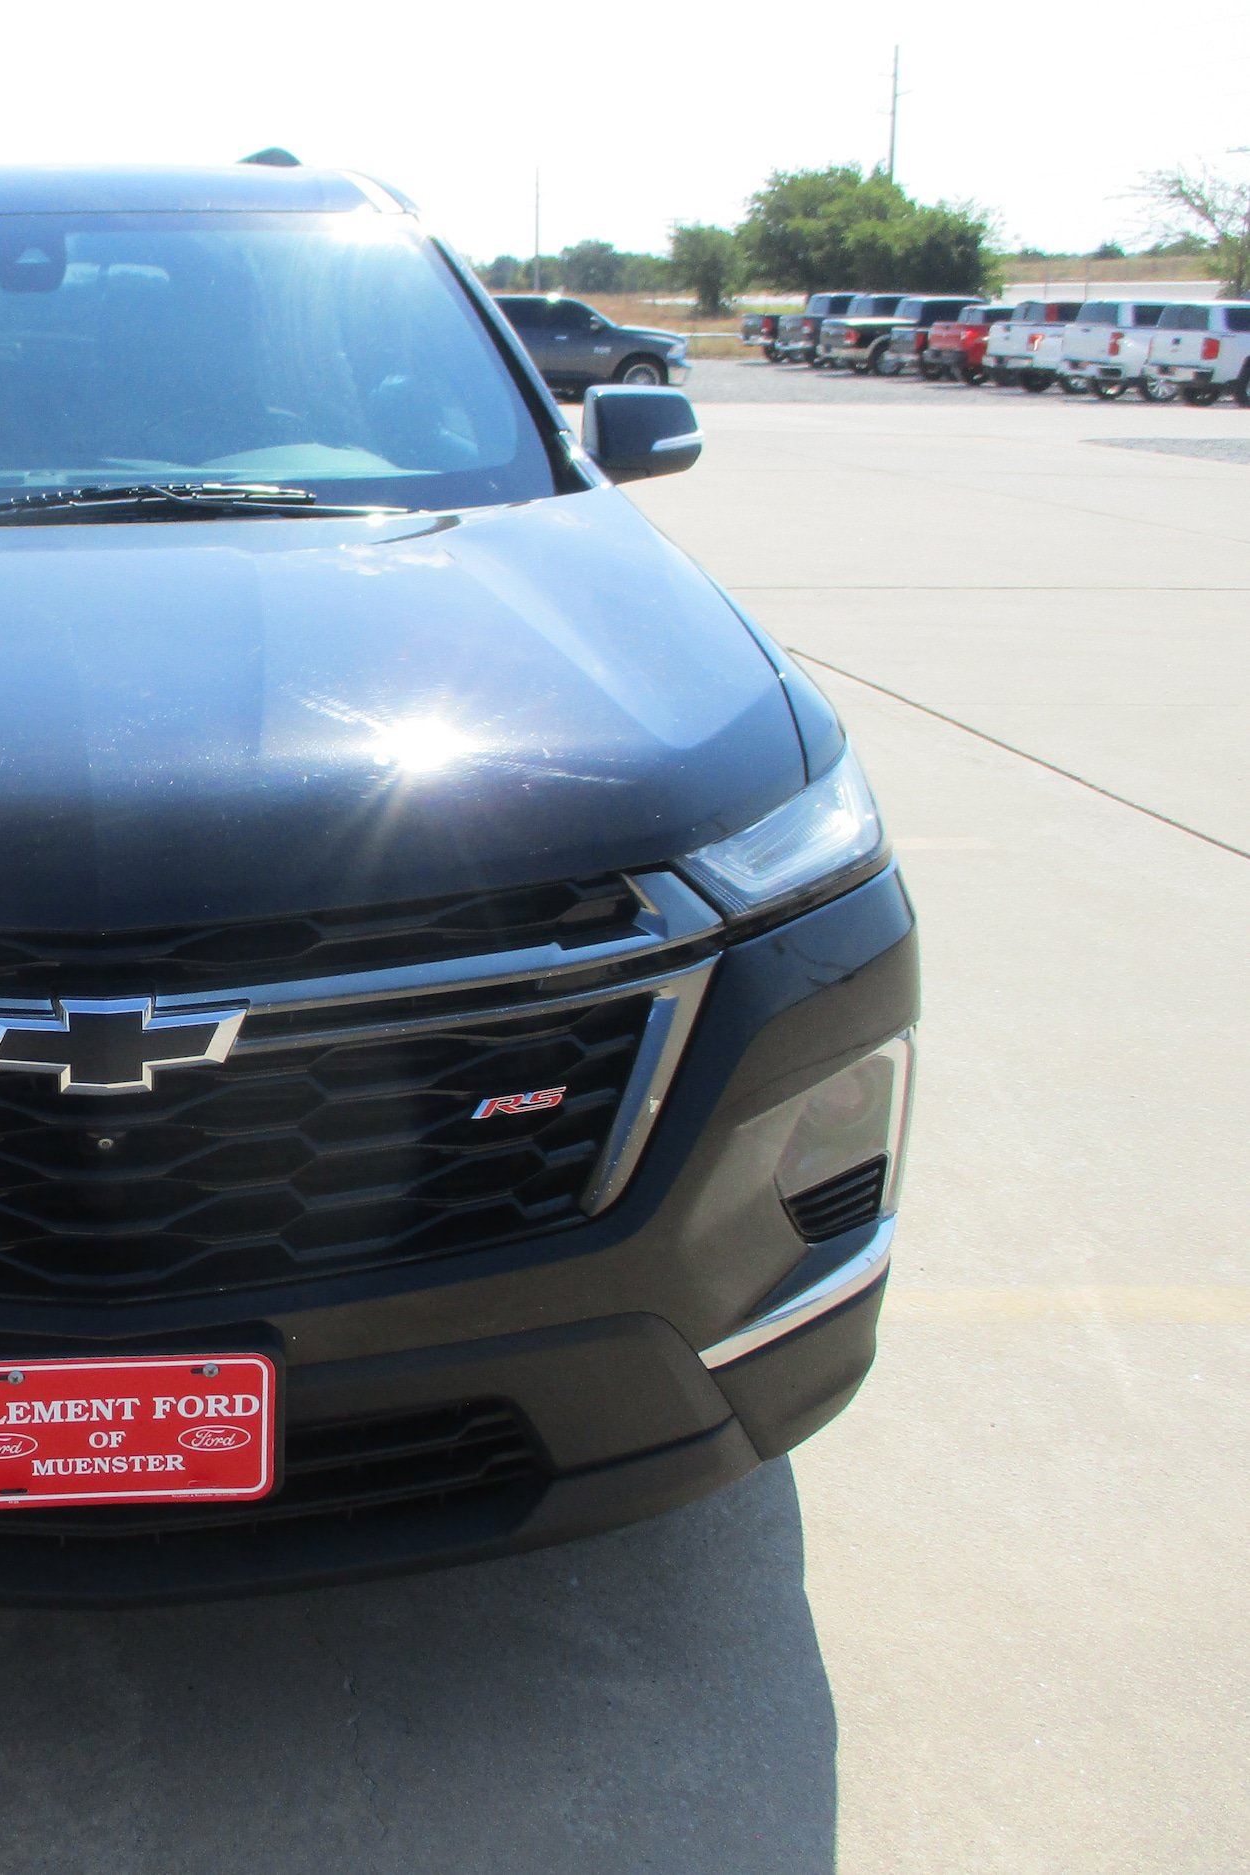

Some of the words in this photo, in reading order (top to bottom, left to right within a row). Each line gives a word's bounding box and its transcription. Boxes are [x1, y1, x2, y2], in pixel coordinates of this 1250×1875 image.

[471, 1086, 567, 1119] RS
[152, 1394, 260, 1419] FORD
[88, 1431, 126, 1449] OF
[191, 1428, 236, 1447] Ford
[31, 1454, 186, 1476] MUENSTER
